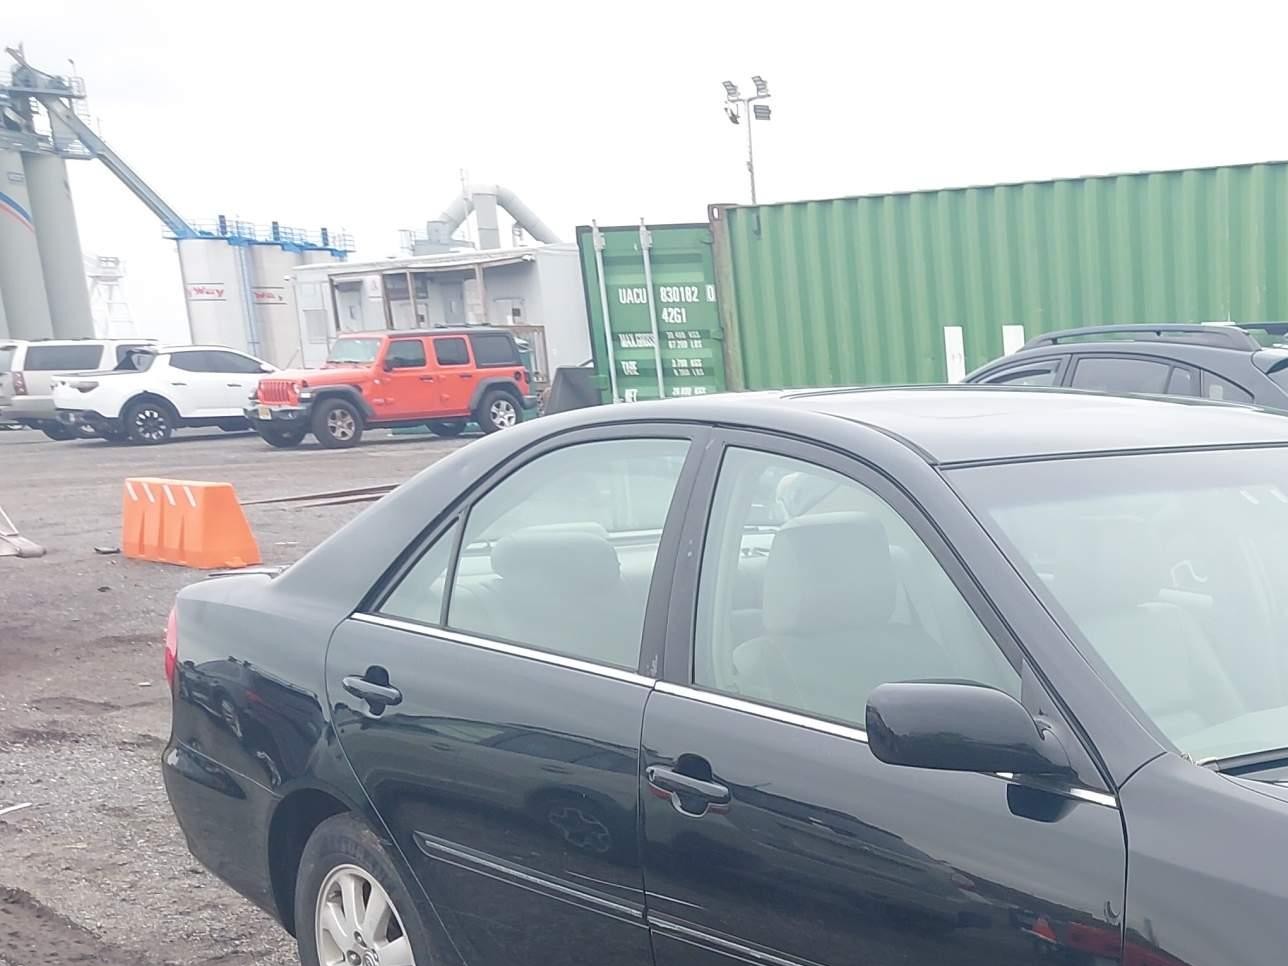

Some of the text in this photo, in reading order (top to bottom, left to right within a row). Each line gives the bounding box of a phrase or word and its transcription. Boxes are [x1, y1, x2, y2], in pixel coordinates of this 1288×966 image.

[618, 287, 648, 304] UACU
[660, 286, 699, 303] 830182
[662, 307, 687, 323] 42G1
